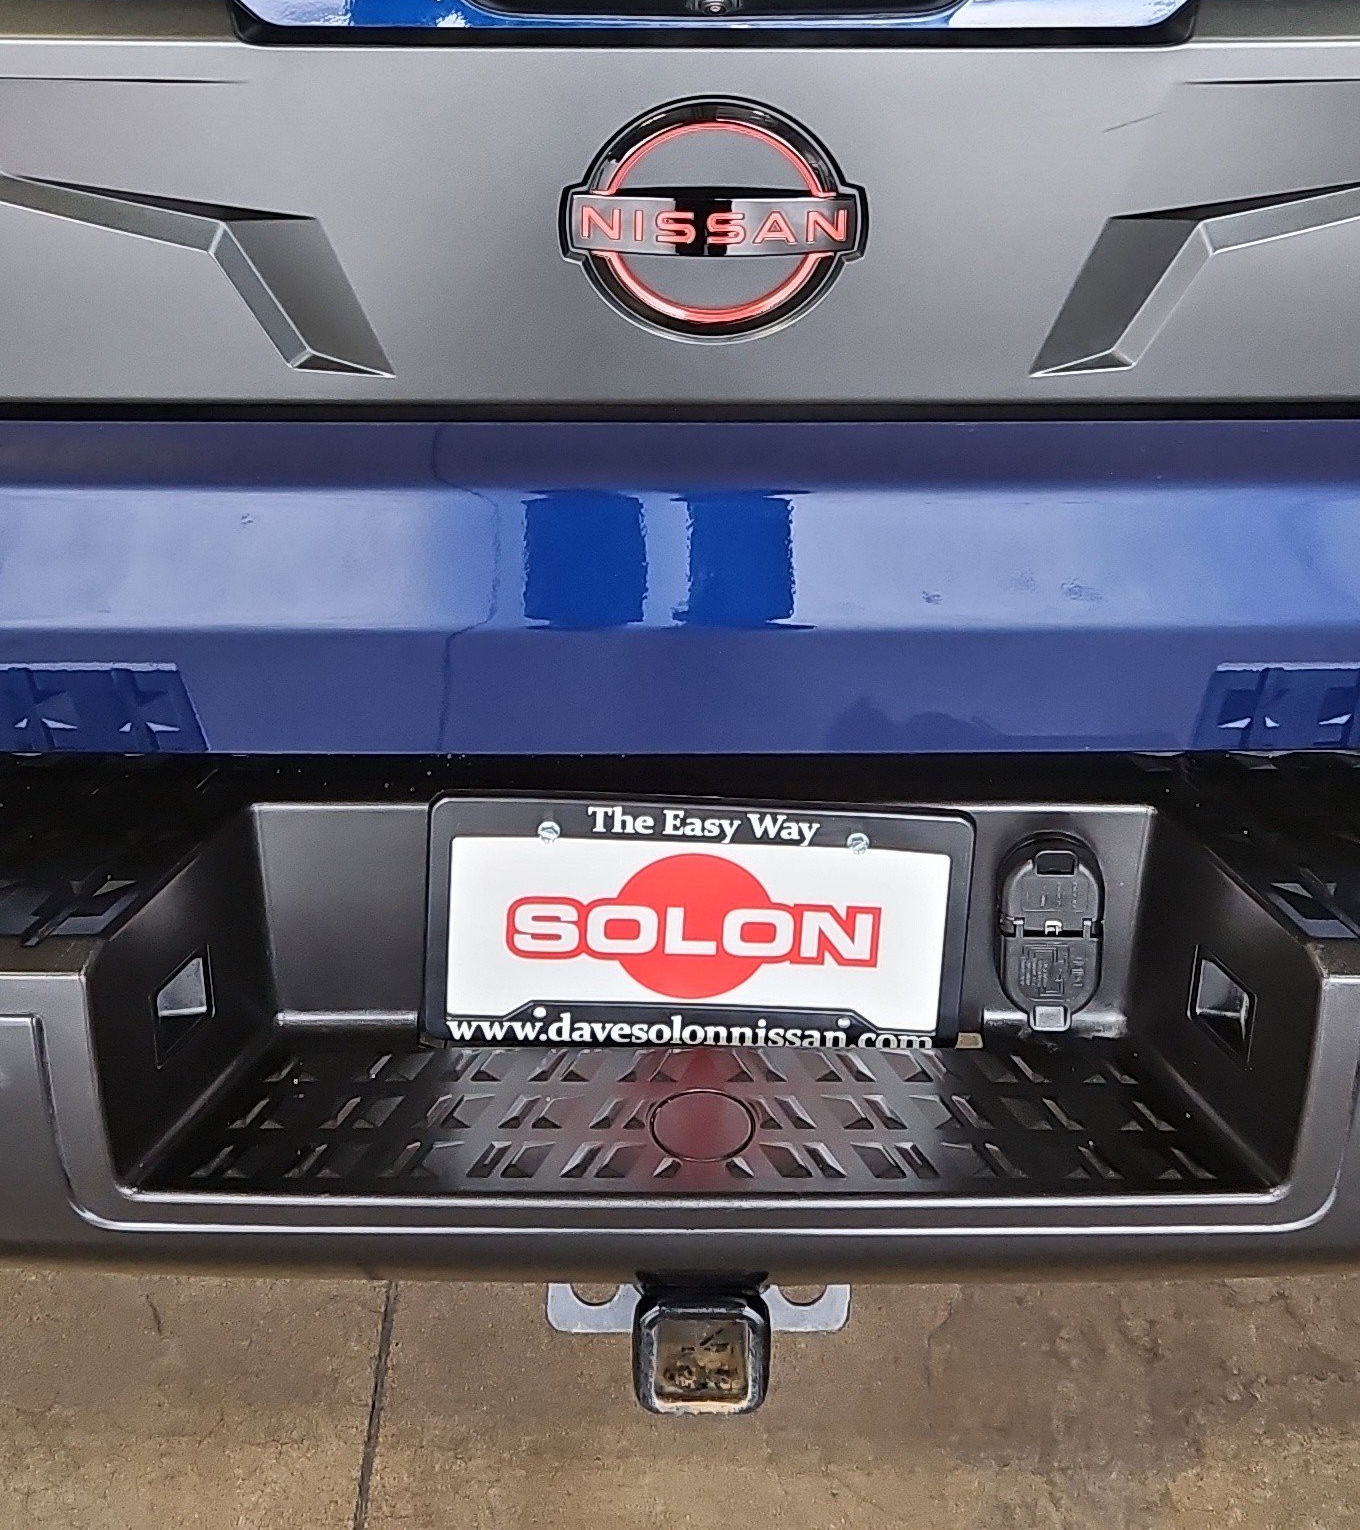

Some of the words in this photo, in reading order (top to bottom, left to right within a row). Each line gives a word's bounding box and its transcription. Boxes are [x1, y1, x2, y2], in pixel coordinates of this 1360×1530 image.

[579, 201, 850, 249] NISSAN
[587, 805, 654, 836] The
[661, 810, 742, 845] Easy
[747, 813, 821, 847] Way
[509, 898, 880, 965] SOLON
